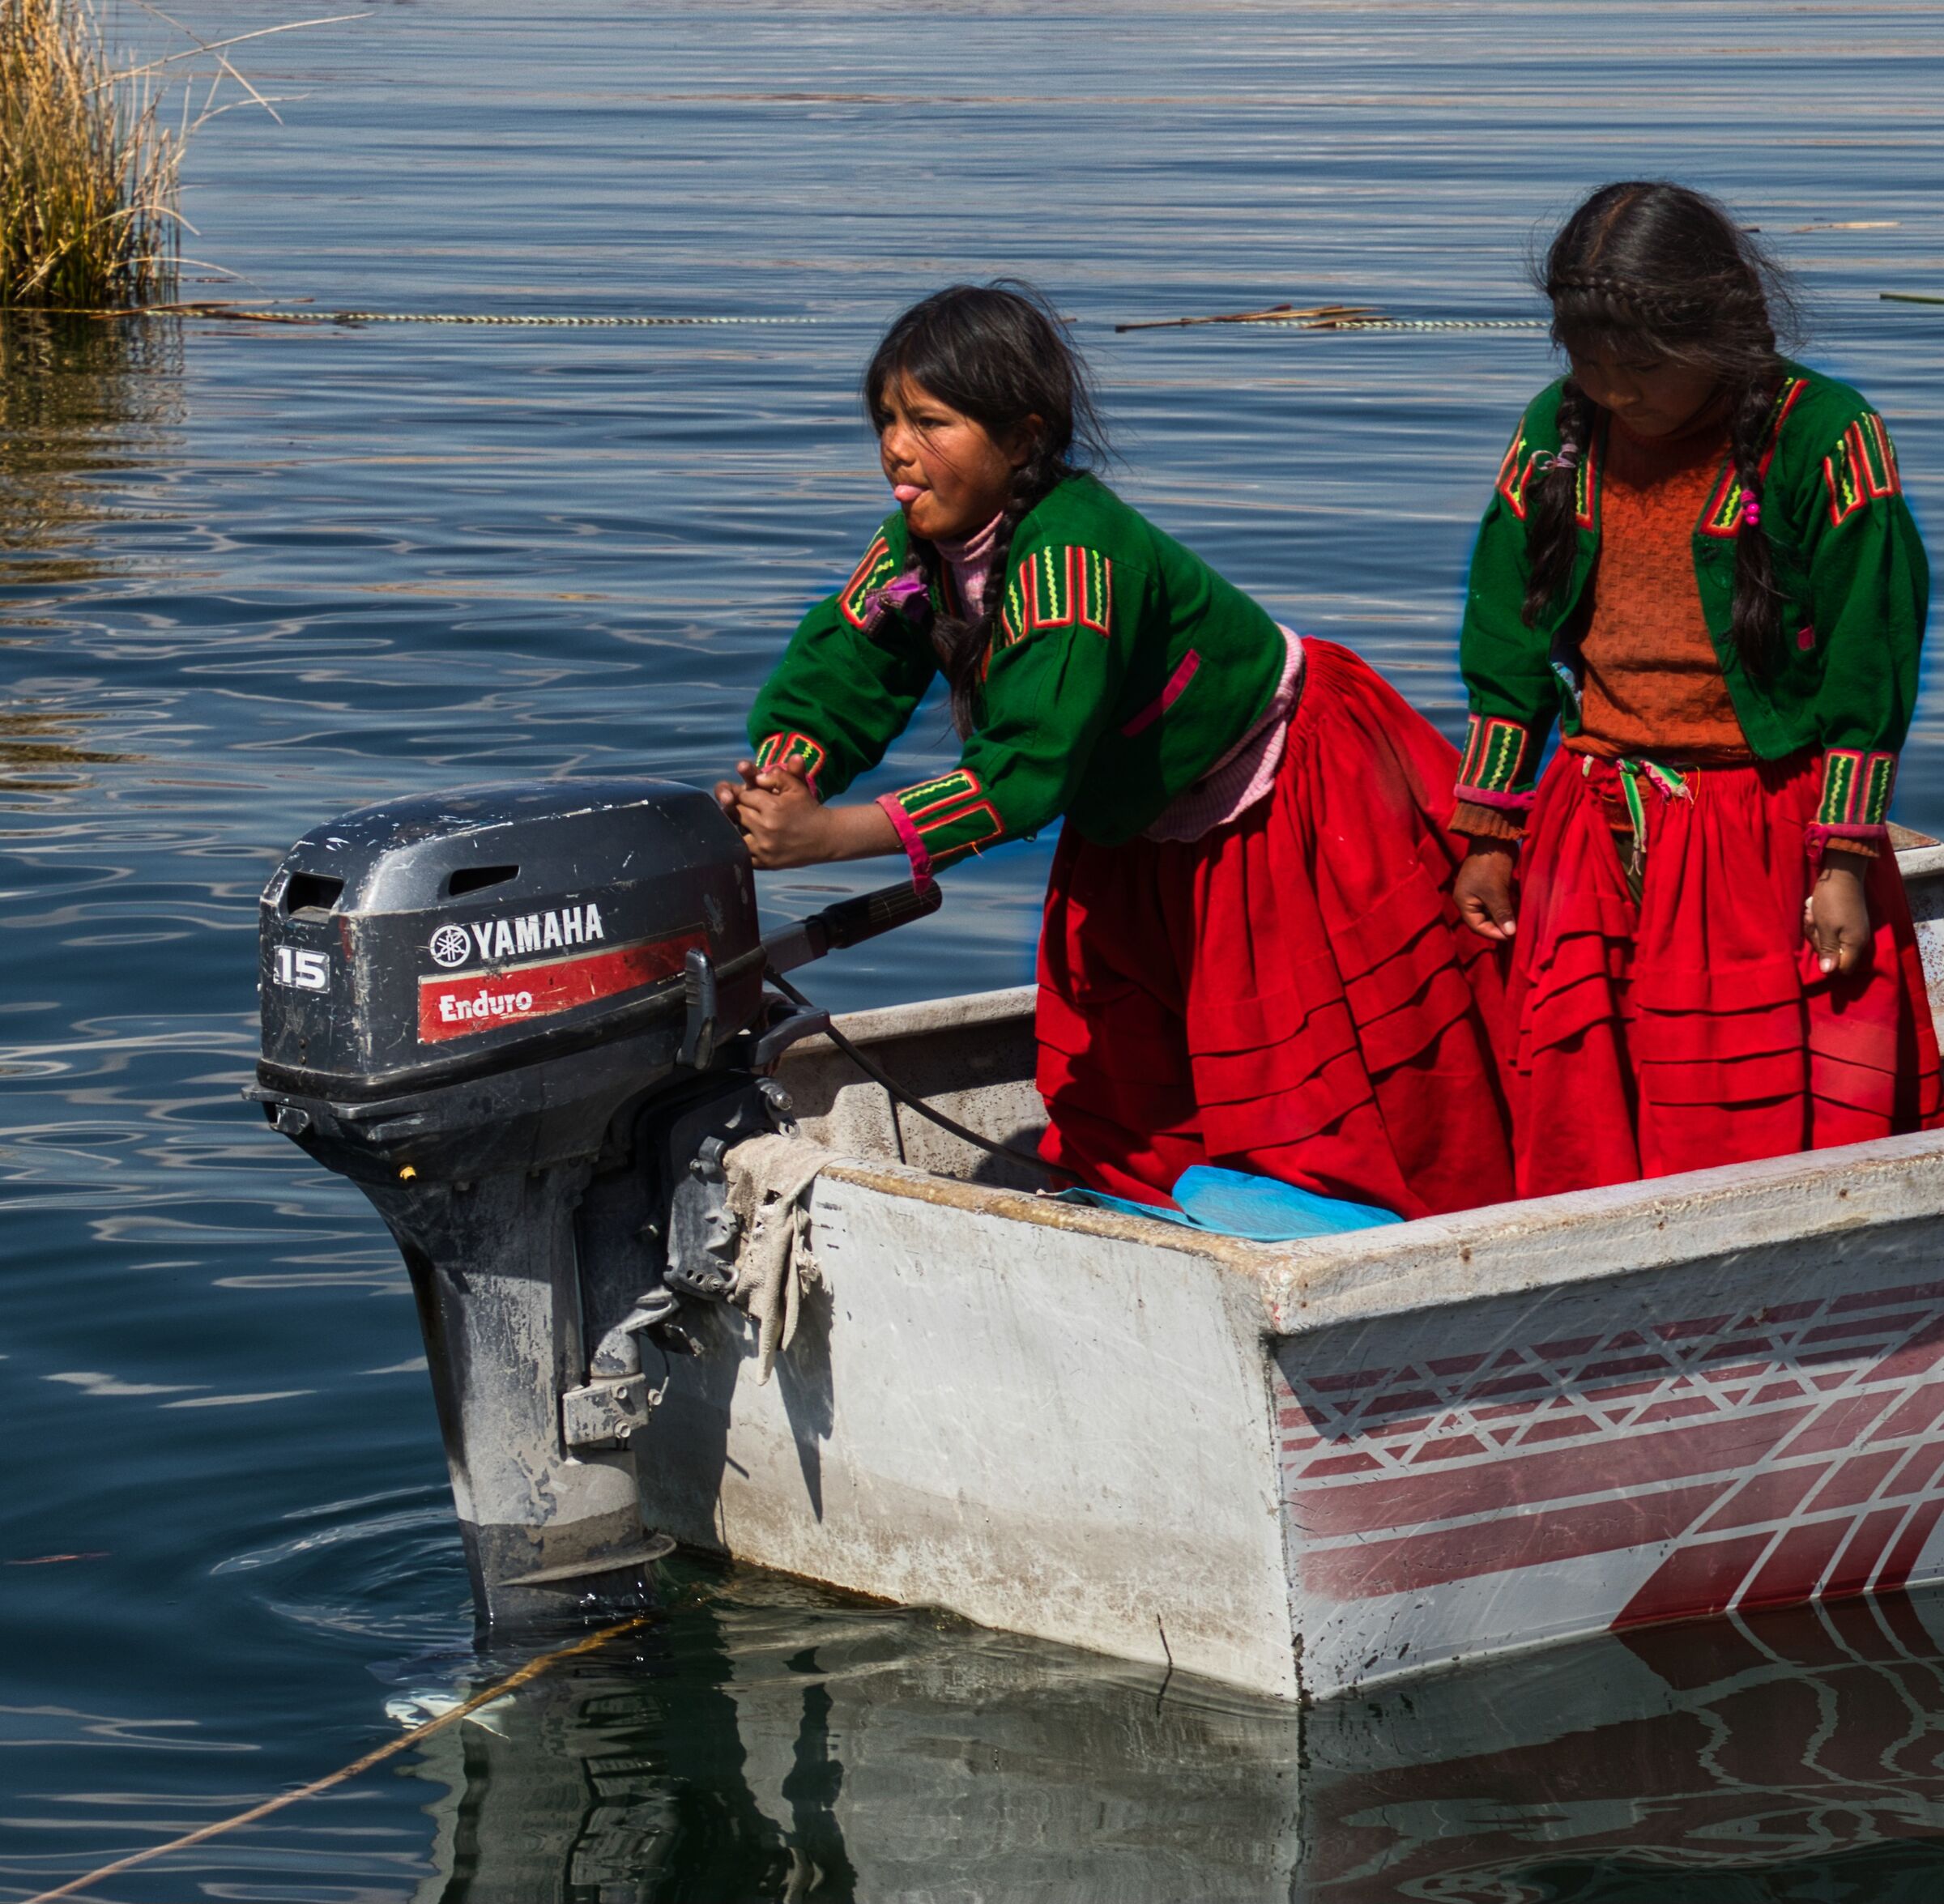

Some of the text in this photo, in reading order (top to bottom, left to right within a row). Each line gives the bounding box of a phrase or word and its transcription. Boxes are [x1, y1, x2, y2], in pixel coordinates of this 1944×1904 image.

[471, 903, 604, 959] YAMAHA
[278, 948, 326, 988] 15
[438, 990, 533, 1022] Enduro
